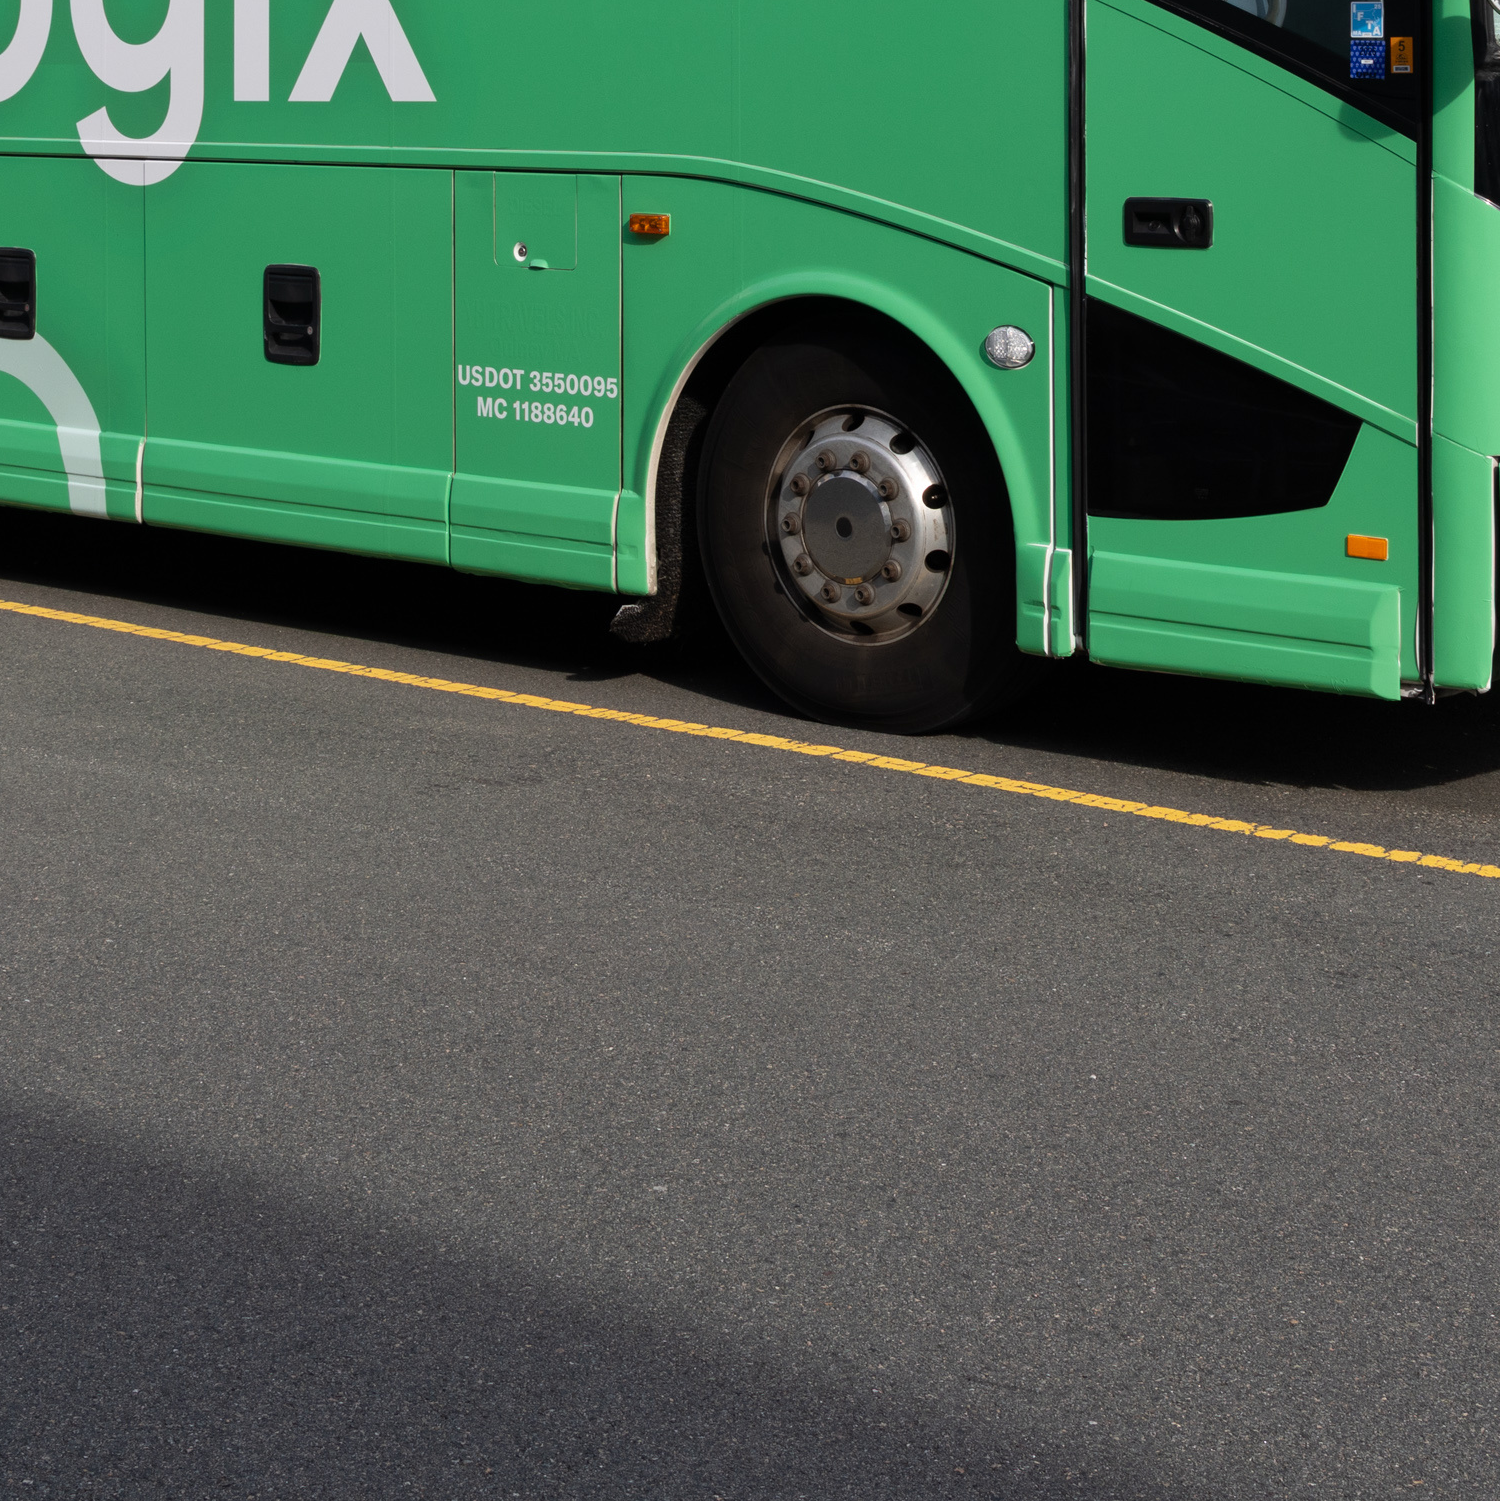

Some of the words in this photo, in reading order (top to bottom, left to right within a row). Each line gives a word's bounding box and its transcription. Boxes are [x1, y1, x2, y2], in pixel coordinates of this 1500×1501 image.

[1398, 40, 1405, 52] 5
[457, 364, 525, 389] USDOT
[529, 370, 618, 398] 3550095
[477, 396, 508, 419] MC
[513, 400, 594, 428] 1188640
